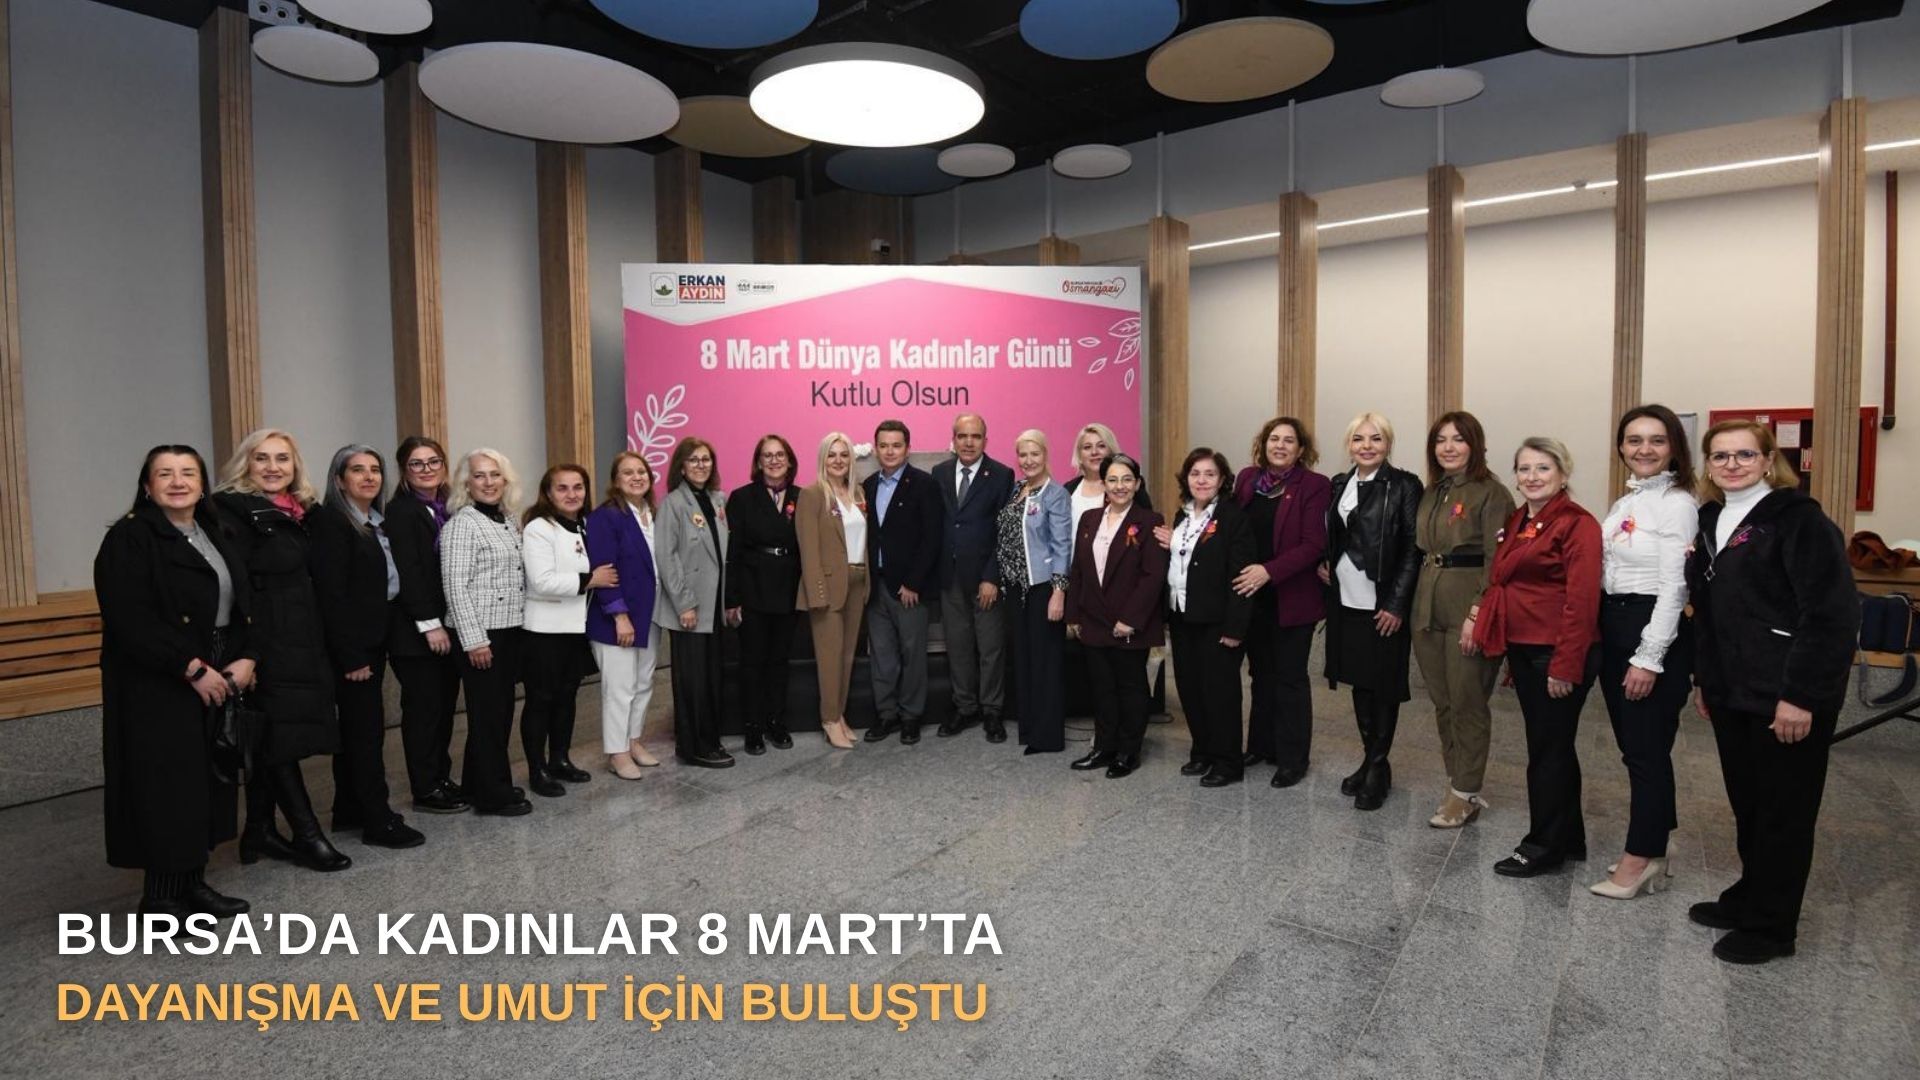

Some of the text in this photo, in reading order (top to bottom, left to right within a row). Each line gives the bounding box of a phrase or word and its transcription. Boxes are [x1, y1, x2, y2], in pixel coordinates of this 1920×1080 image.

[679, 275, 725, 286] ERKAN
[681, 287, 724, 300] AYDIN
[700, 337, 1072, 376] 8 Mart Dünya Kadınlar Günü
[811, 380, 969, 407] Kutlu Olsun
